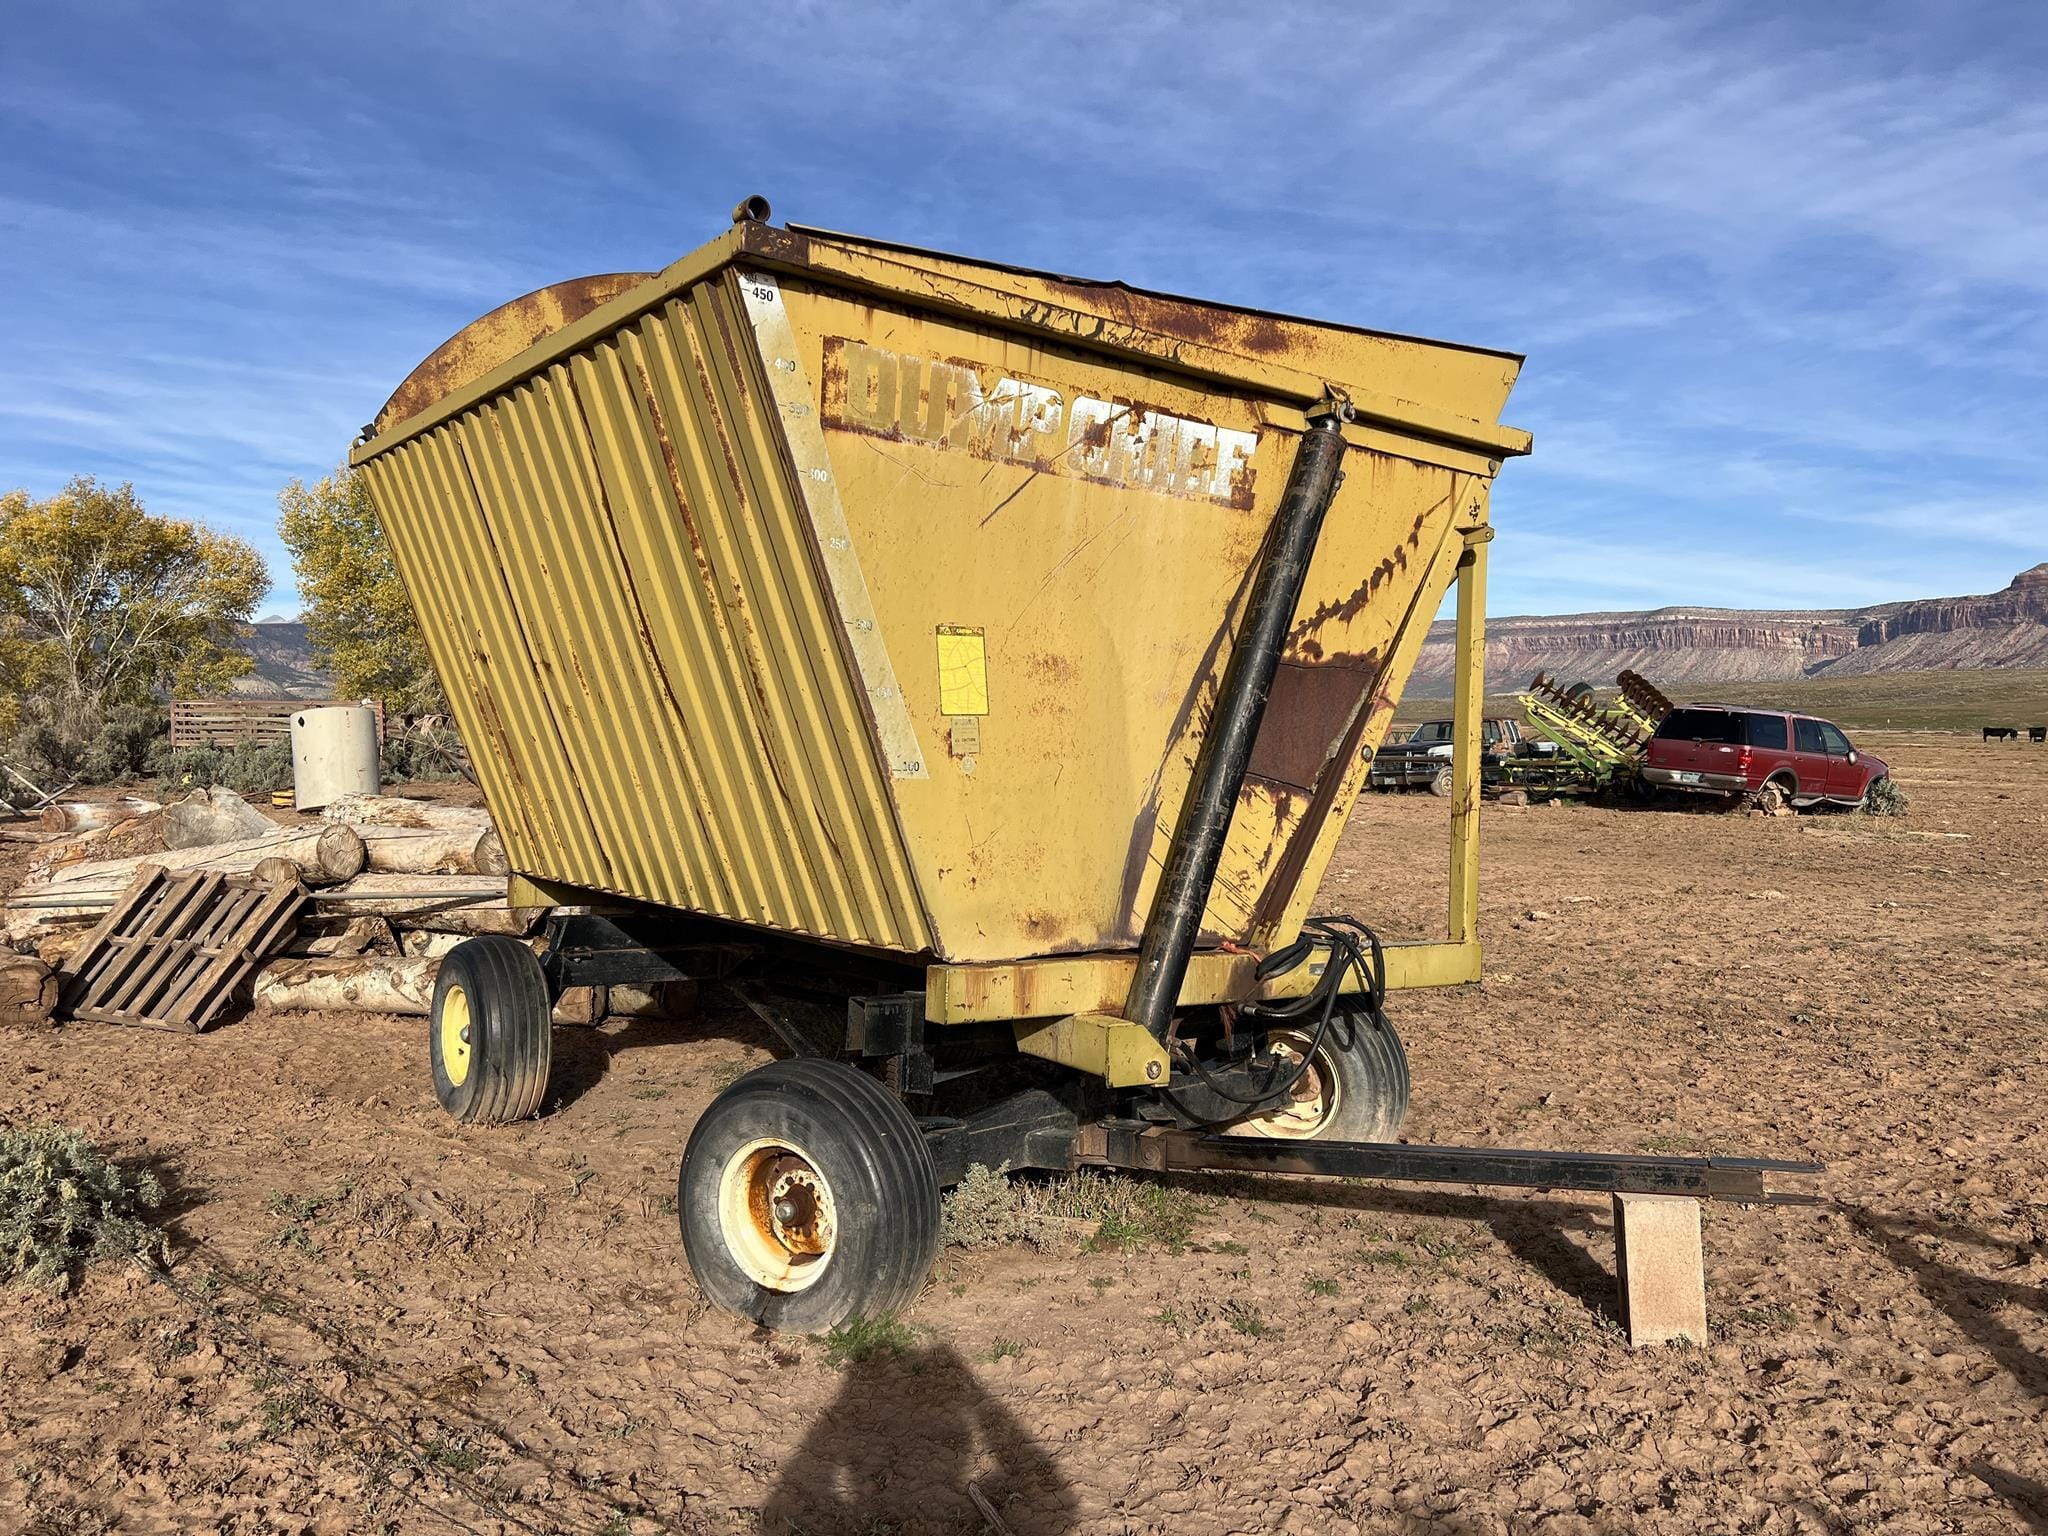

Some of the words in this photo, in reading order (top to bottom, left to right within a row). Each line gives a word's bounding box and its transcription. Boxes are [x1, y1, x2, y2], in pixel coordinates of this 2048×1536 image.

[752, 287, 774, 302] 450
[844, 341, 1062, 462] DUMP
[1067, 395, 1258, 498] CHIEF
